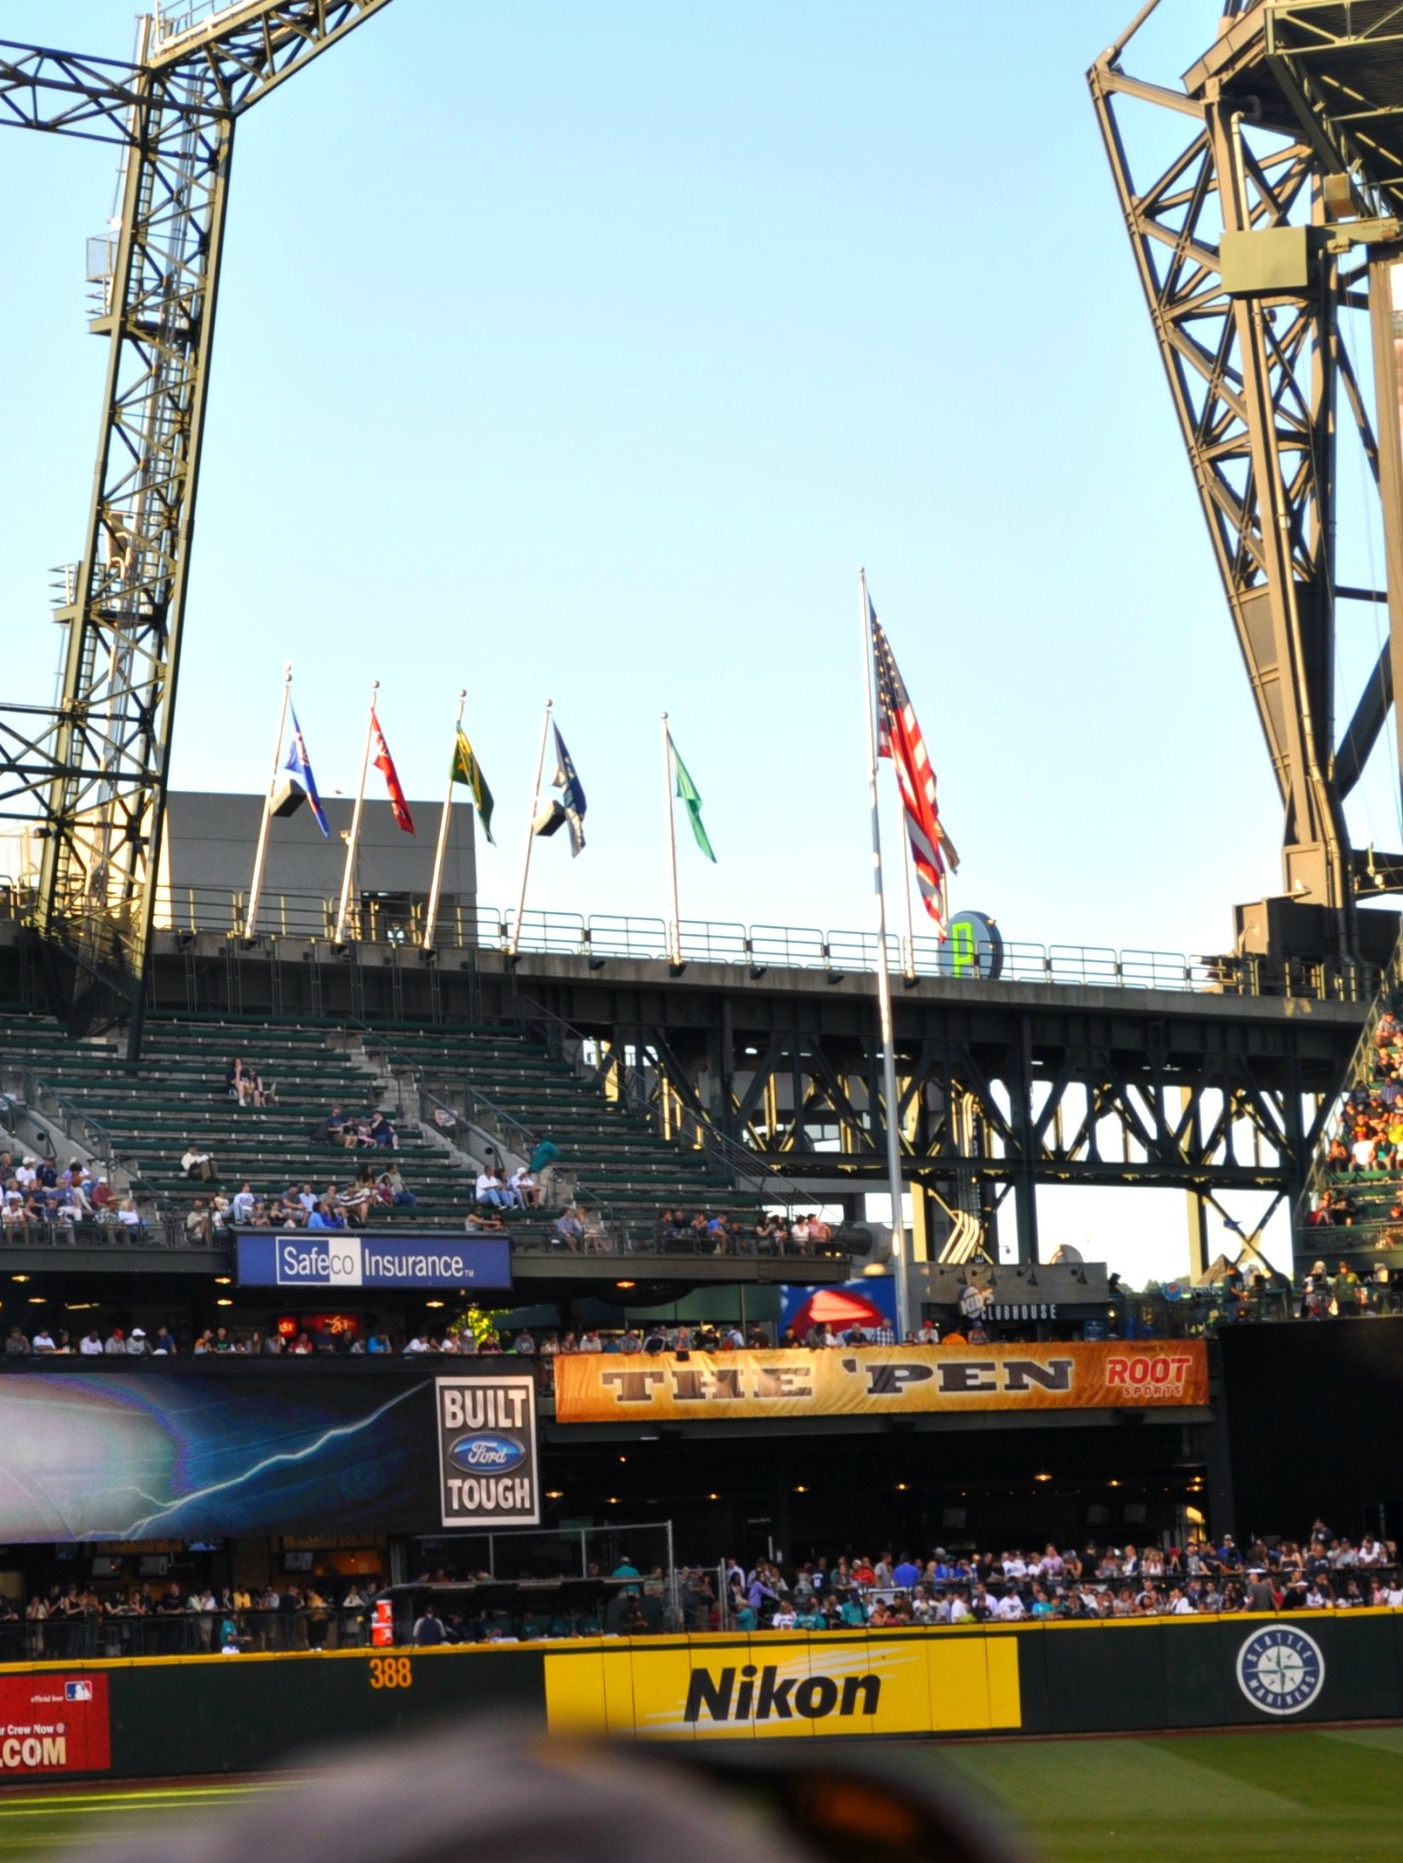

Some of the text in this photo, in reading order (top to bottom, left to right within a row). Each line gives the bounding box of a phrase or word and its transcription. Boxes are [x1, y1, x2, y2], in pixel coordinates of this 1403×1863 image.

[283, 1246, 355, 1276] Safeco
[364, 1248, 464, 1278] Insurance
[980, 1304, 1058, 1321] CLUBHOUSE
[601, 1367, 813, 1402] THE
[1107, 1356, 1192, 1385] ROOT
[1122, 1384, 1184, 1398] SPORTS
[444, 1389, 527, 1429] BUILT
[468, 1441, 508, 1464] Ford
[447, 1478, 531, 1510] TOUGH
[1246, 1633, 1313, 1663] SEATTLE
[369, 1657, 413, 1689] 388
[683, 1664, 881, 1722] Nikon
[1248, 1675, 1317, 1707] MARINERS
[7, 1724, 32, 1736] Crew
[33, 1723, 55, 1734] Now
